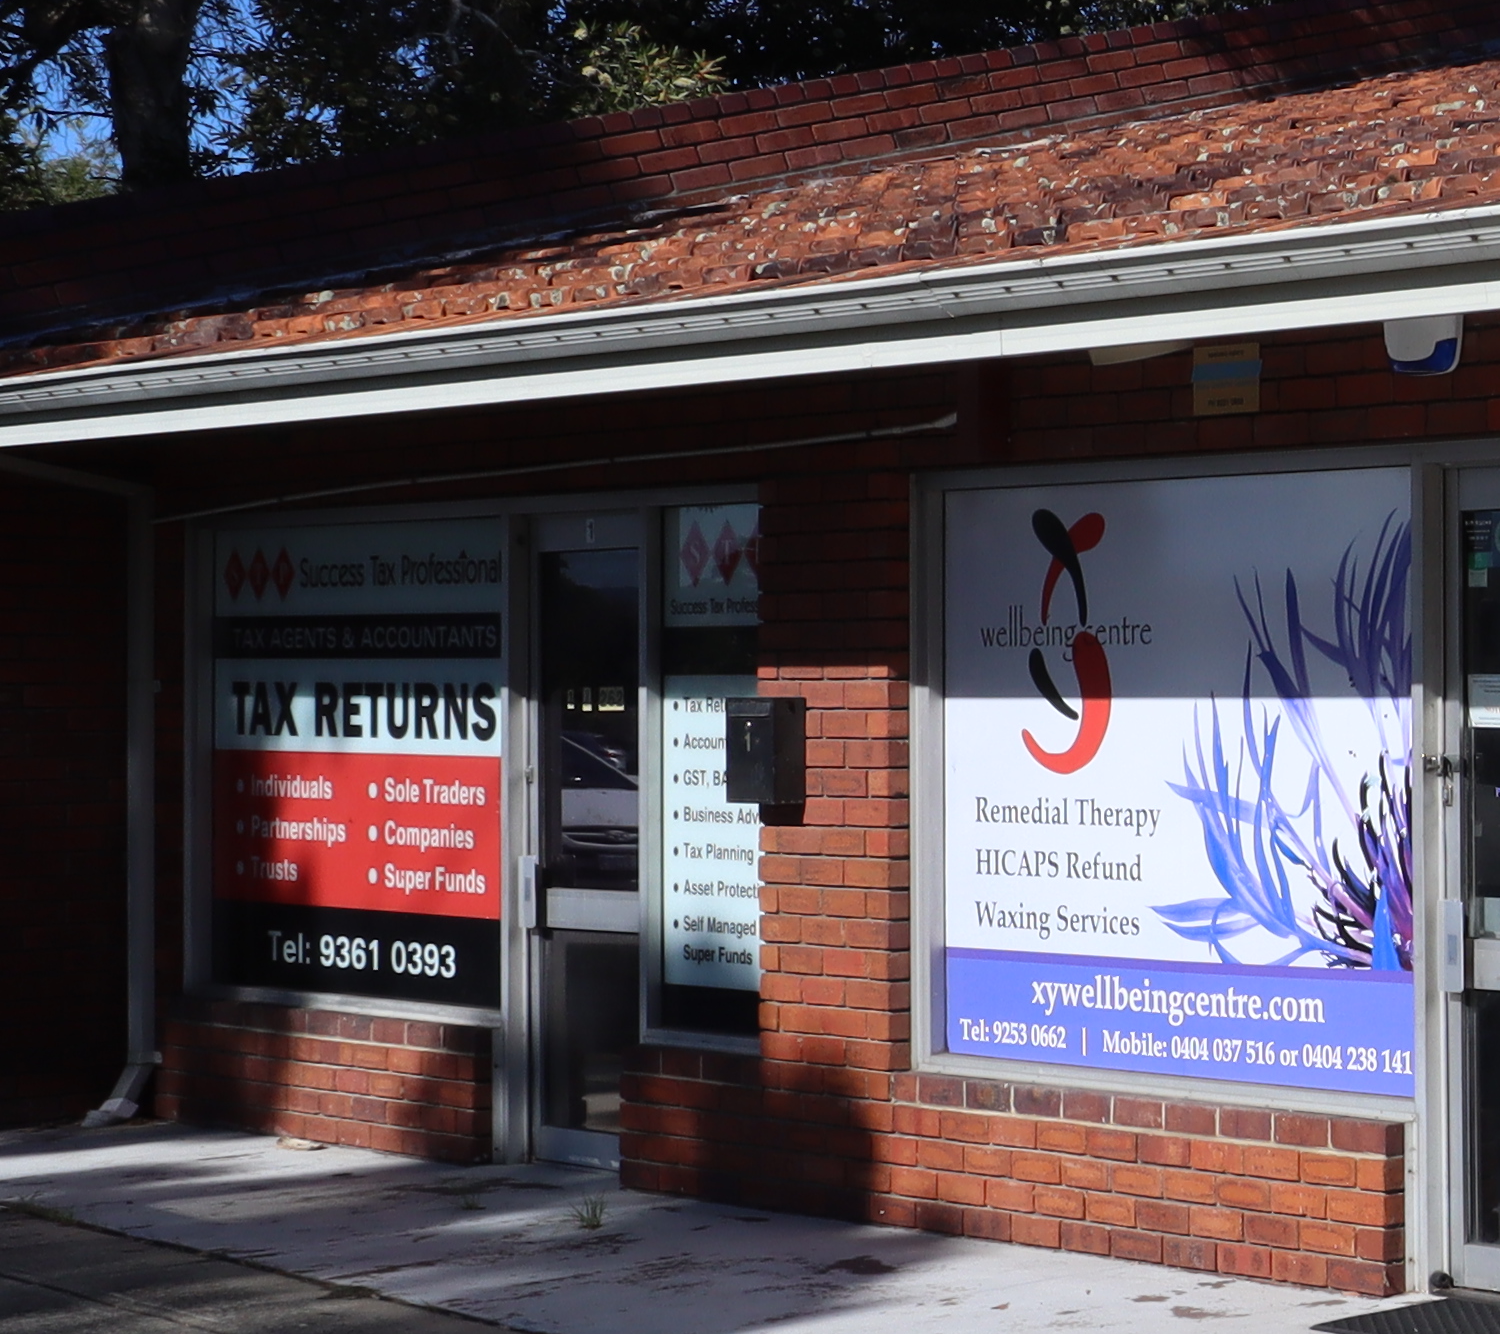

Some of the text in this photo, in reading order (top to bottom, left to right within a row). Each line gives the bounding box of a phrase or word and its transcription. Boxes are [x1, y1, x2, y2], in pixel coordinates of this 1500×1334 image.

[300, 557, 364, 587] Success
[370, 555, 395, 586] Tax
[670, 599, 707, 615] Success
[710, 598, 724, 614] Tax
[234, 625, 497, 649] TAX AGENTS & ACCOUNTANTS
[980, 605, 1076, 662] wellbeing
[232, 681, 497, 742] TAX RETURNS
[684, 697, 703, 713] Tax
[684, 733, 727, 750] Accoun
[251, 774, 332, 800] Individuals
[384, 777, 486, 806] Sole Traders
[684, 769, 711, 789] GST,
[684, 806, 734, 824] Business
[975, 796, 1161, 837] Remedial Therapy
[251, 816, 346, 847] Partnerships
[384, 820, 475, 852] Companies
[684, 843, 754, 865] Tax Planning
[975, 849, 1142, 882] HICAPS Refund
[251, 856, 298, 882] Trusts
[384, 863, 486, 895] Super Funds
[684, 880, 714, 897] Asset
[684, 915, 756, 938] Self Managed
[975, 900, 1141, 940] Waxing Services
[268, 930, 456, 978] Tel: 9361 0393
[684, 944, 753, 965] Super Funds
[1031, 974, 1326, 1026] xywellbeingcentre.com
[960, 1017, 1412, 1074] Tel: 9253 0662 Mobile: 0404 037 516 or 0404 238 141
